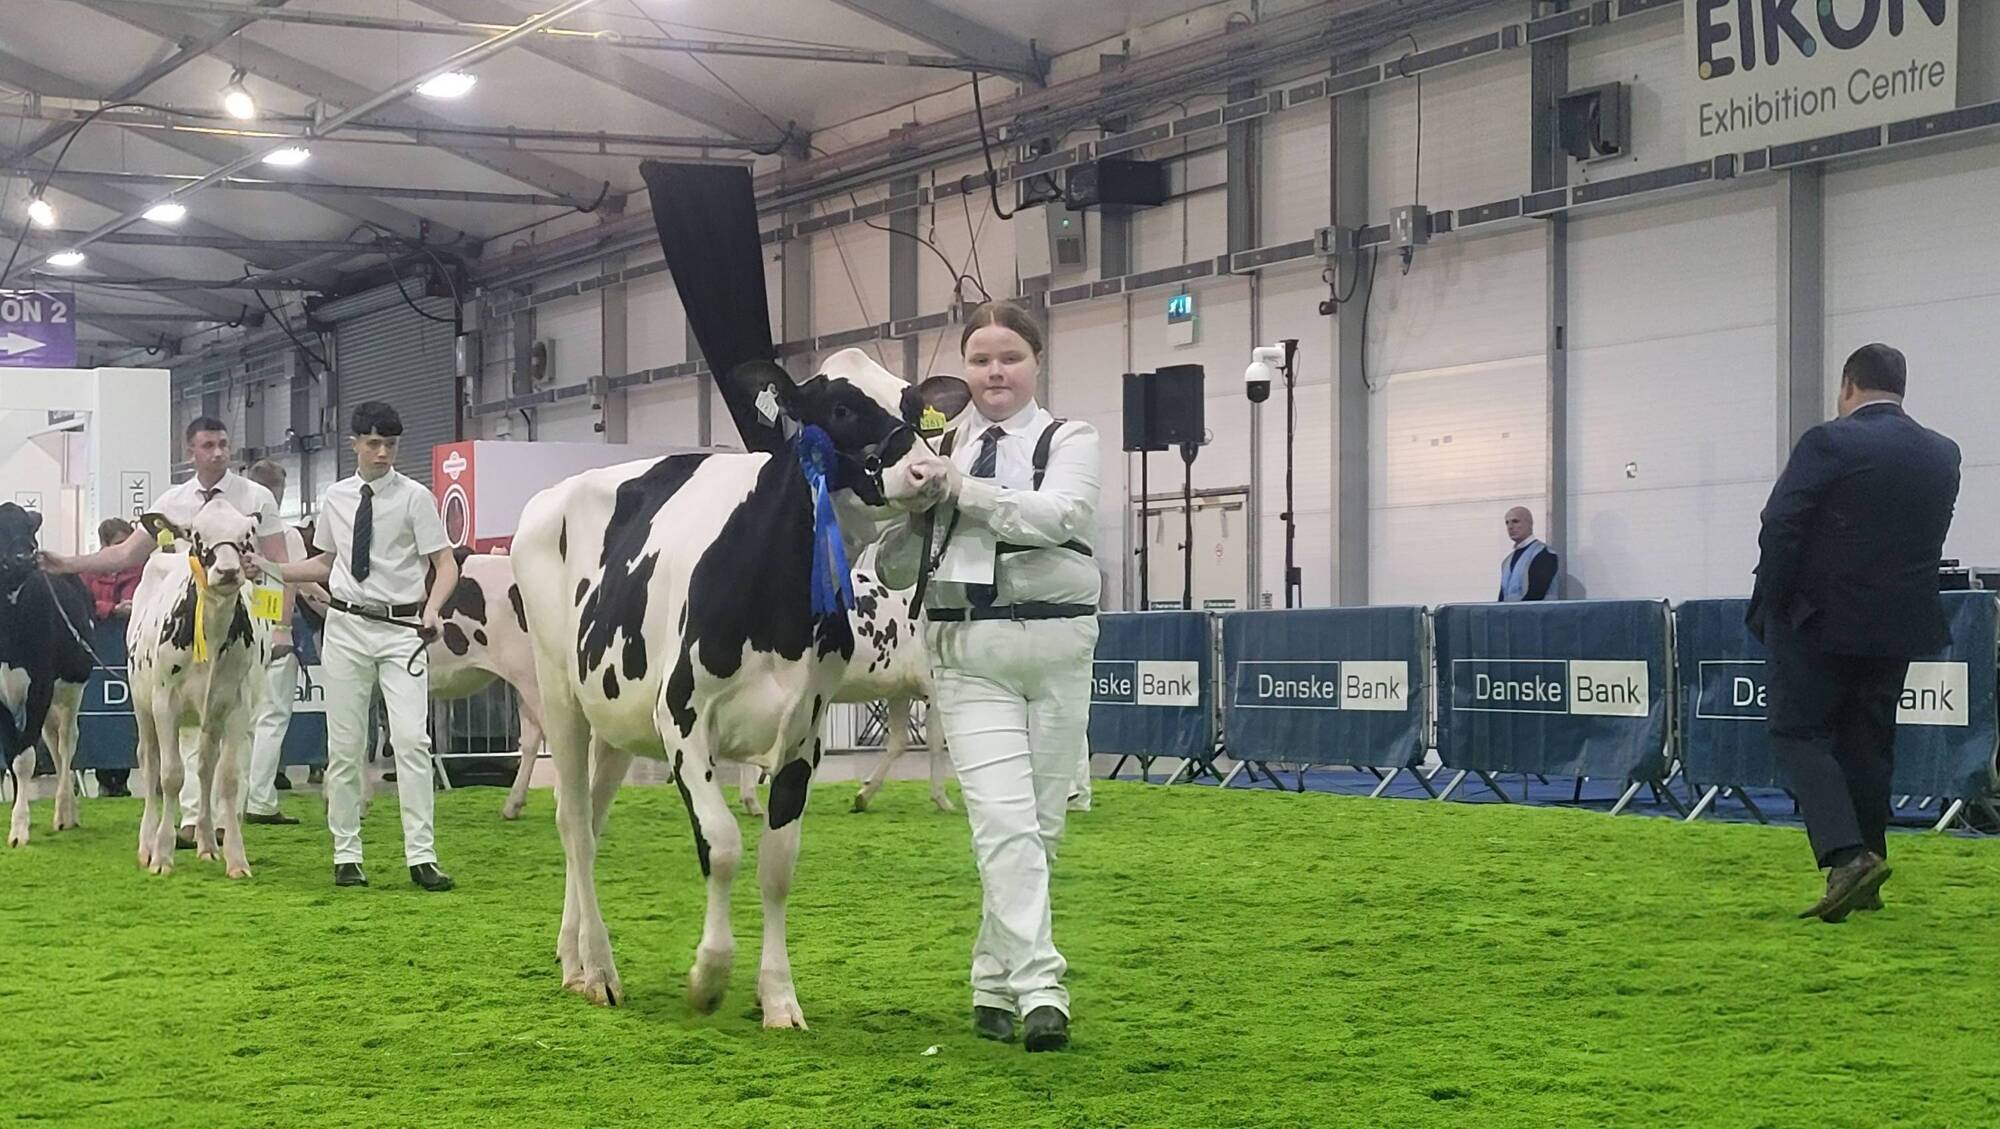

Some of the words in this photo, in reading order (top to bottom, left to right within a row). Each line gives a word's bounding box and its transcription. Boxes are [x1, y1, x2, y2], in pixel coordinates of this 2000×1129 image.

[1700, 86, 1836, 137] Exhibition
[1848, 60, 1945, 105] Centre
[51, 301, 67, 323] 2
[1092, 672, 1131, 695] nske
[1143, 673, 1193, 696] Bank
[1258, 673, 1334, 699] Danske
[1346, 675, 1401, 700] Bank
[1476, 674, 1561, 702] Danske
[1577, 675, 1641, 704] Bank
[1899, 680, 1954, 711] ank
